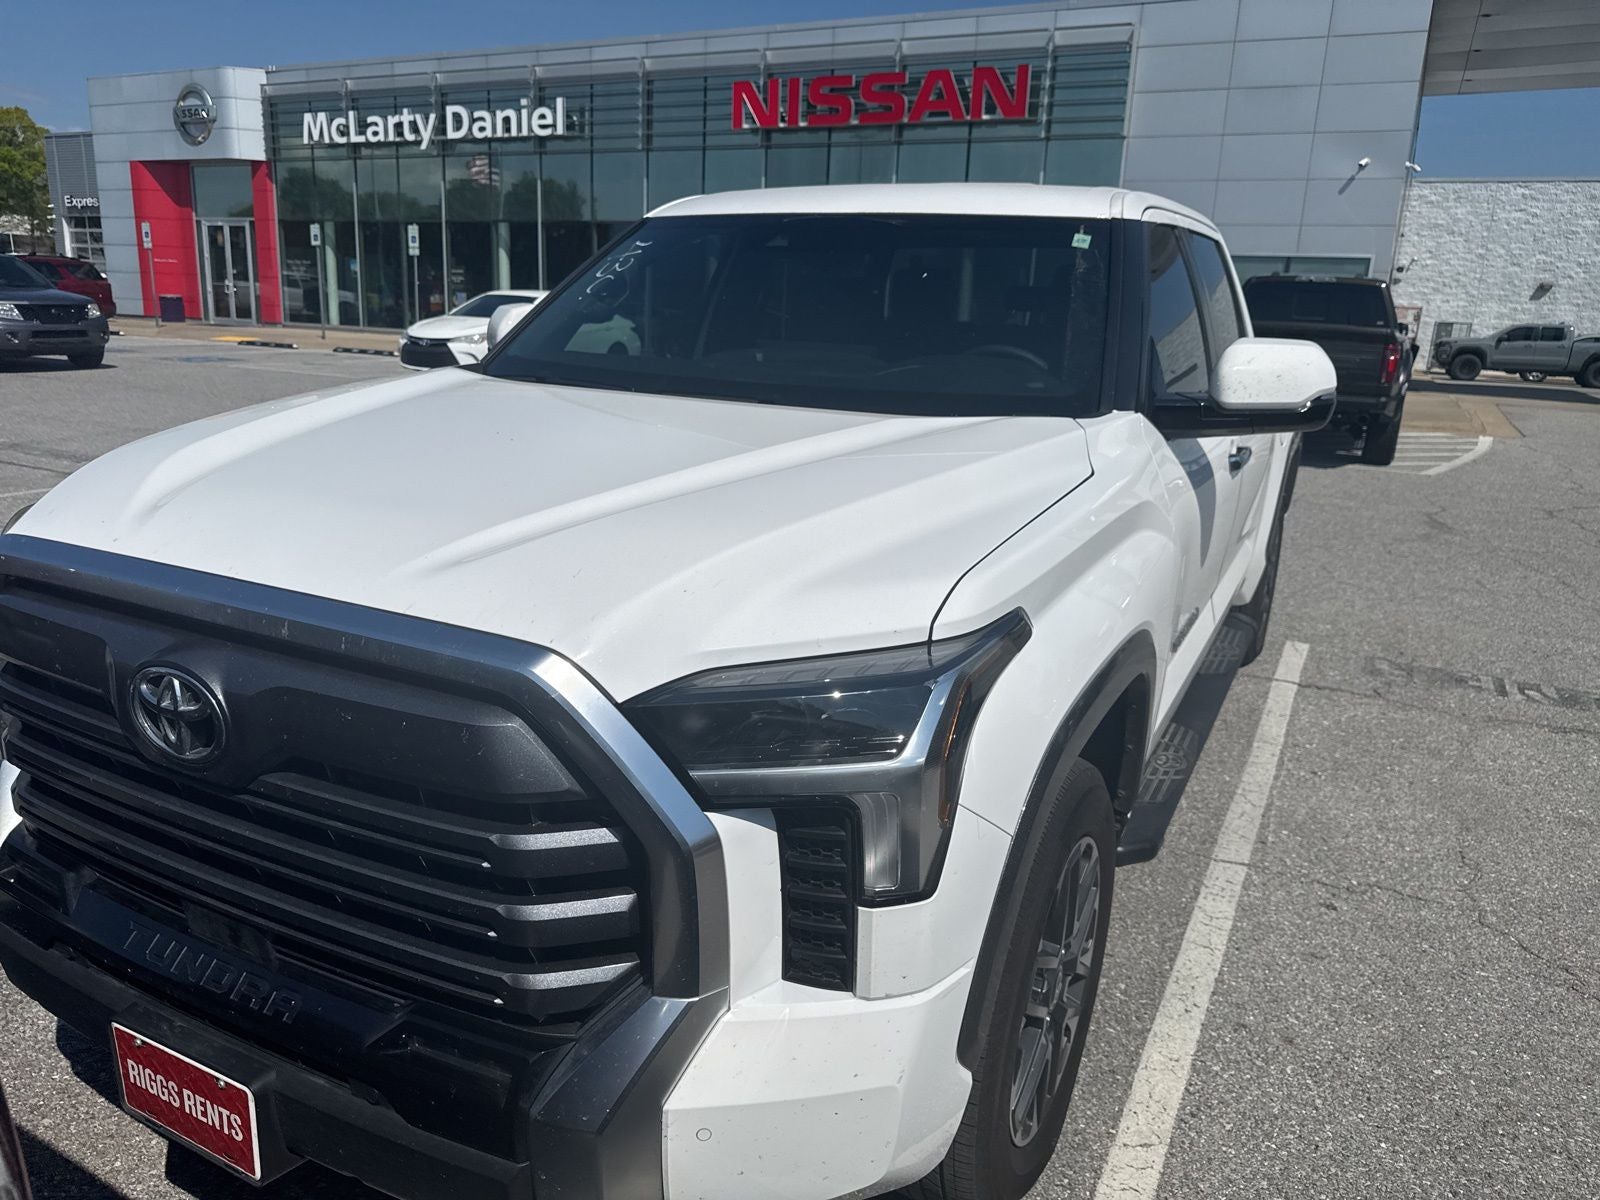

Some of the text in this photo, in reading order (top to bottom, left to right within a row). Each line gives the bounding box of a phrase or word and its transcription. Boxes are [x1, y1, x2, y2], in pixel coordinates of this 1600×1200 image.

[177, 107, 210, 120] SSAN
[303, 96, 564, 150] McLarty Daniel
[732, 64, 1031, 129] NISSAN
[122, 921, 302, 1025] TUNDRA
[126, 1058, 244, 1142] RIGGS RENTS
